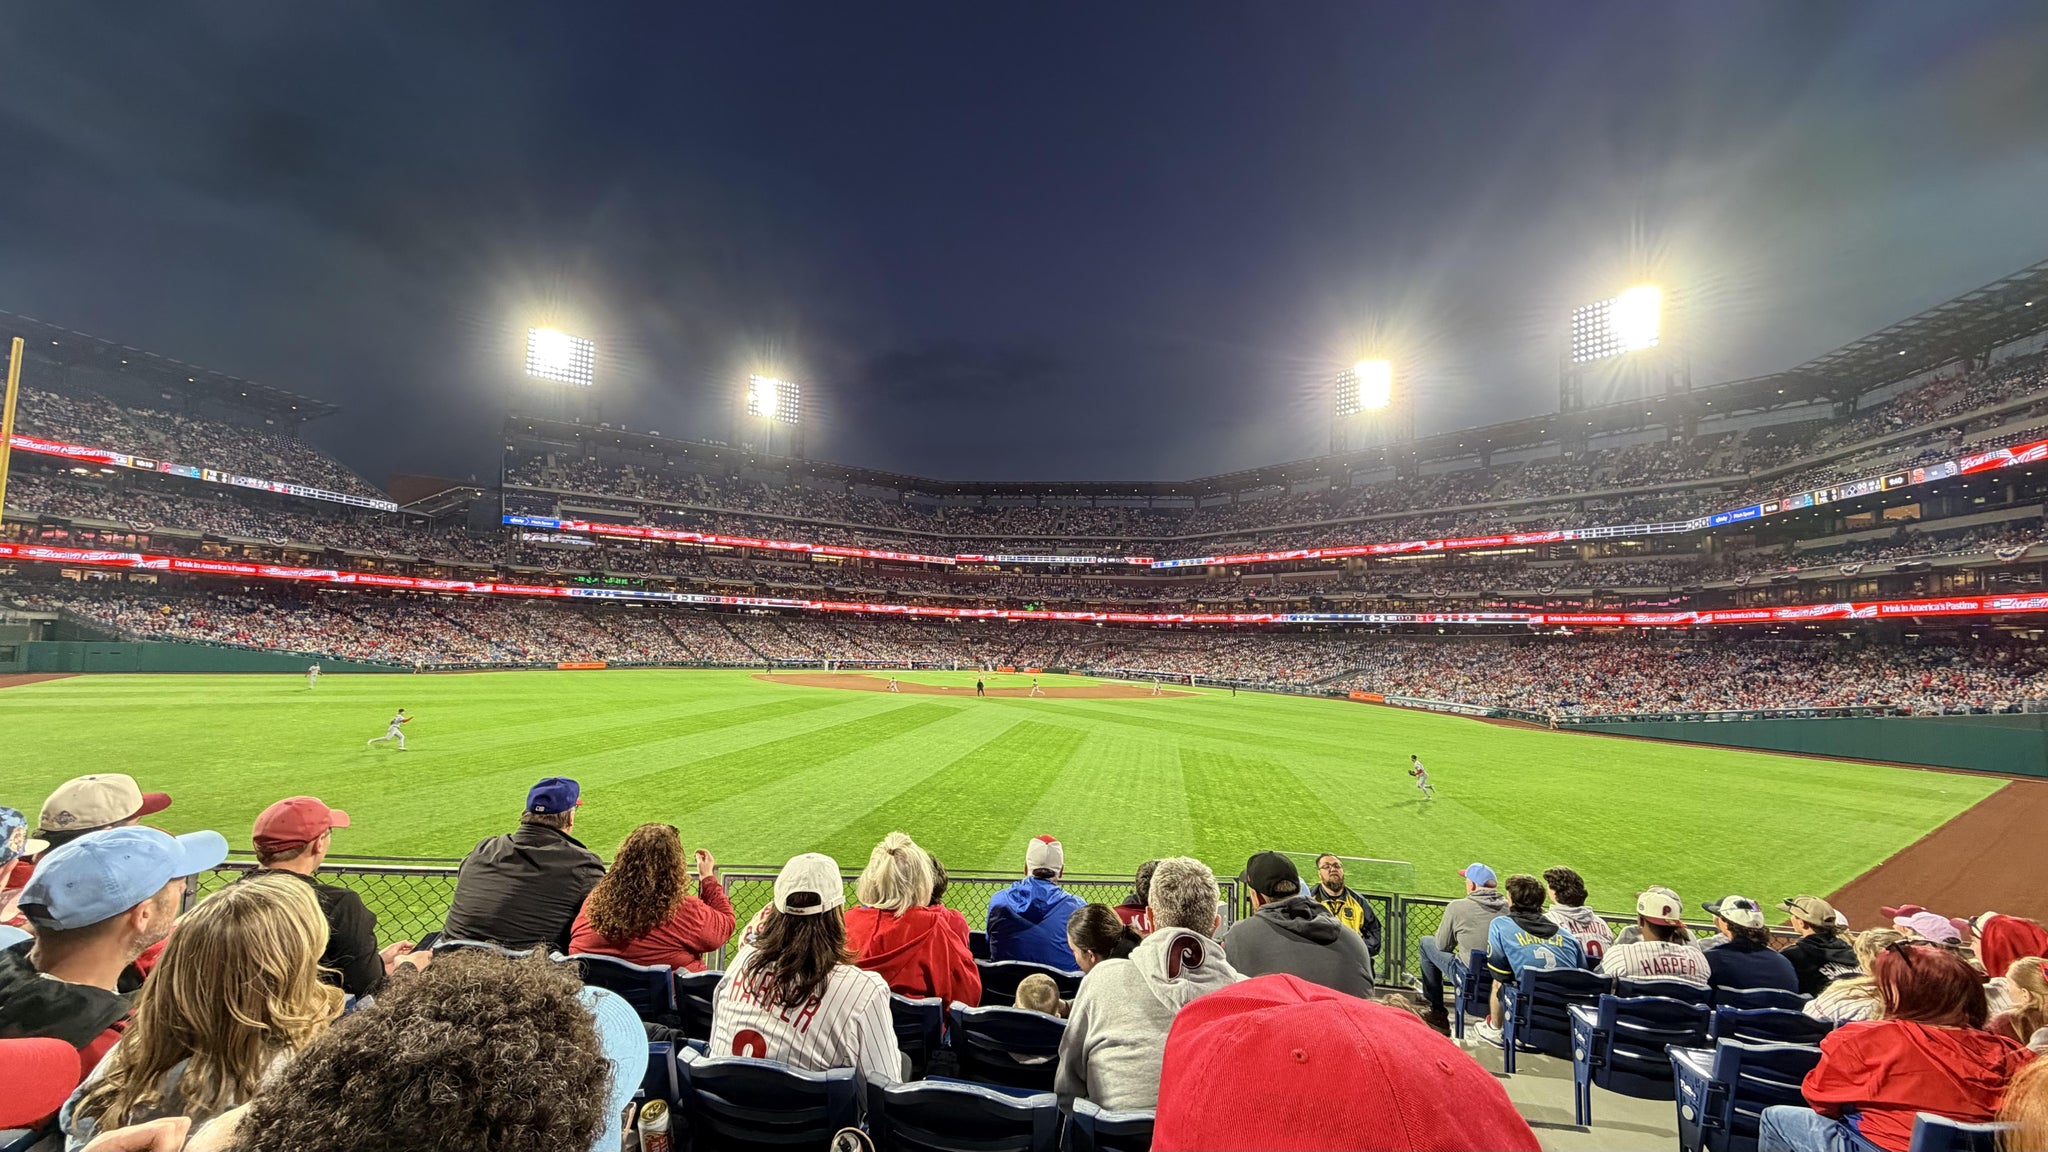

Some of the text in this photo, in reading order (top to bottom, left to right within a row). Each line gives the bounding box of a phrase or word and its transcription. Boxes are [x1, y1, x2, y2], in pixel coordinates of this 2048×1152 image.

[1882, 604, 1901, 613] Drink
[1901, 604, 1908, 612] in
[1909, 603, 1945, 611] America's
[1946, 601, 1978, 610] Pastime
[1560, 920, 1608, 937] ALMUTO
[1515, 932, 1563, 947] HARER
[1167, 933, 1205, 980] P
[1641, 957, 1696, 976] HARPER
